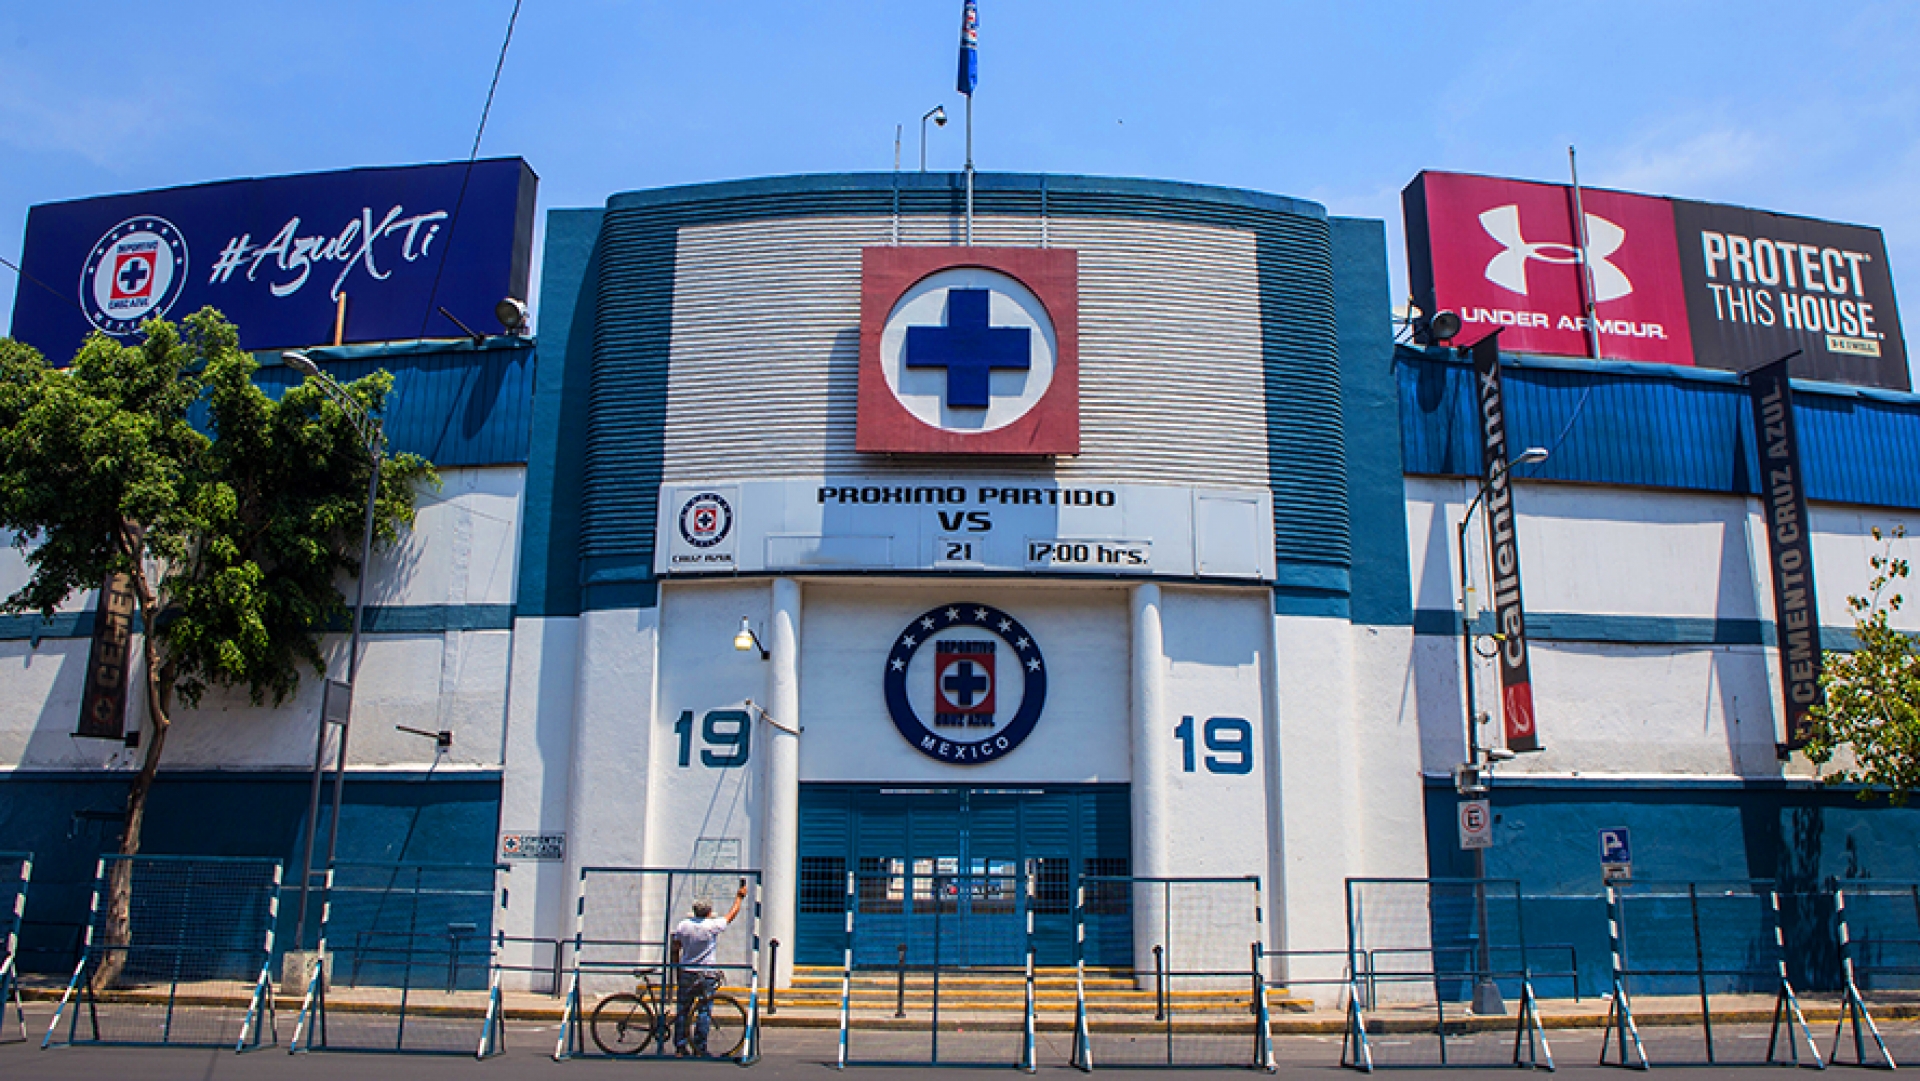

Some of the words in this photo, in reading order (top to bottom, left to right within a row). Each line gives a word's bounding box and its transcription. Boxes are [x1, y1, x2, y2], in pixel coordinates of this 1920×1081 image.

[208, 205, 448, 302] #AzulXTi
[1702, 230, 1865, 297] PROTECT
[1461, 307, 1550, 329] UNDER
[1706, 283, 1776, 327] THIS
[1780, 292, 1886, 340] HOUSE.
[1762, 376, 1789, 459] AZUL
[818, 487, 967, 505] PROXIMO
[979, 488, 1116, 507] PARTIDO
[938, 511, 992, 532] VS
[1480, 361, 1525, 668] caliente.mx
[1771, 465, 1800, 544] CRUZ
[946, 542, 972, 561] 21
[1028, 543, 1089, 563] 17:00
[1097, 544, 1148, 565] hrs.
[1779, 548, 1815, 704] CEMENTO
[674, 710, 751, 769] 19
[920, 734, 1009, 760] MEXICO
[1174, 716, 1254, 775] 19
[1601, 831, 1623, 857] P
